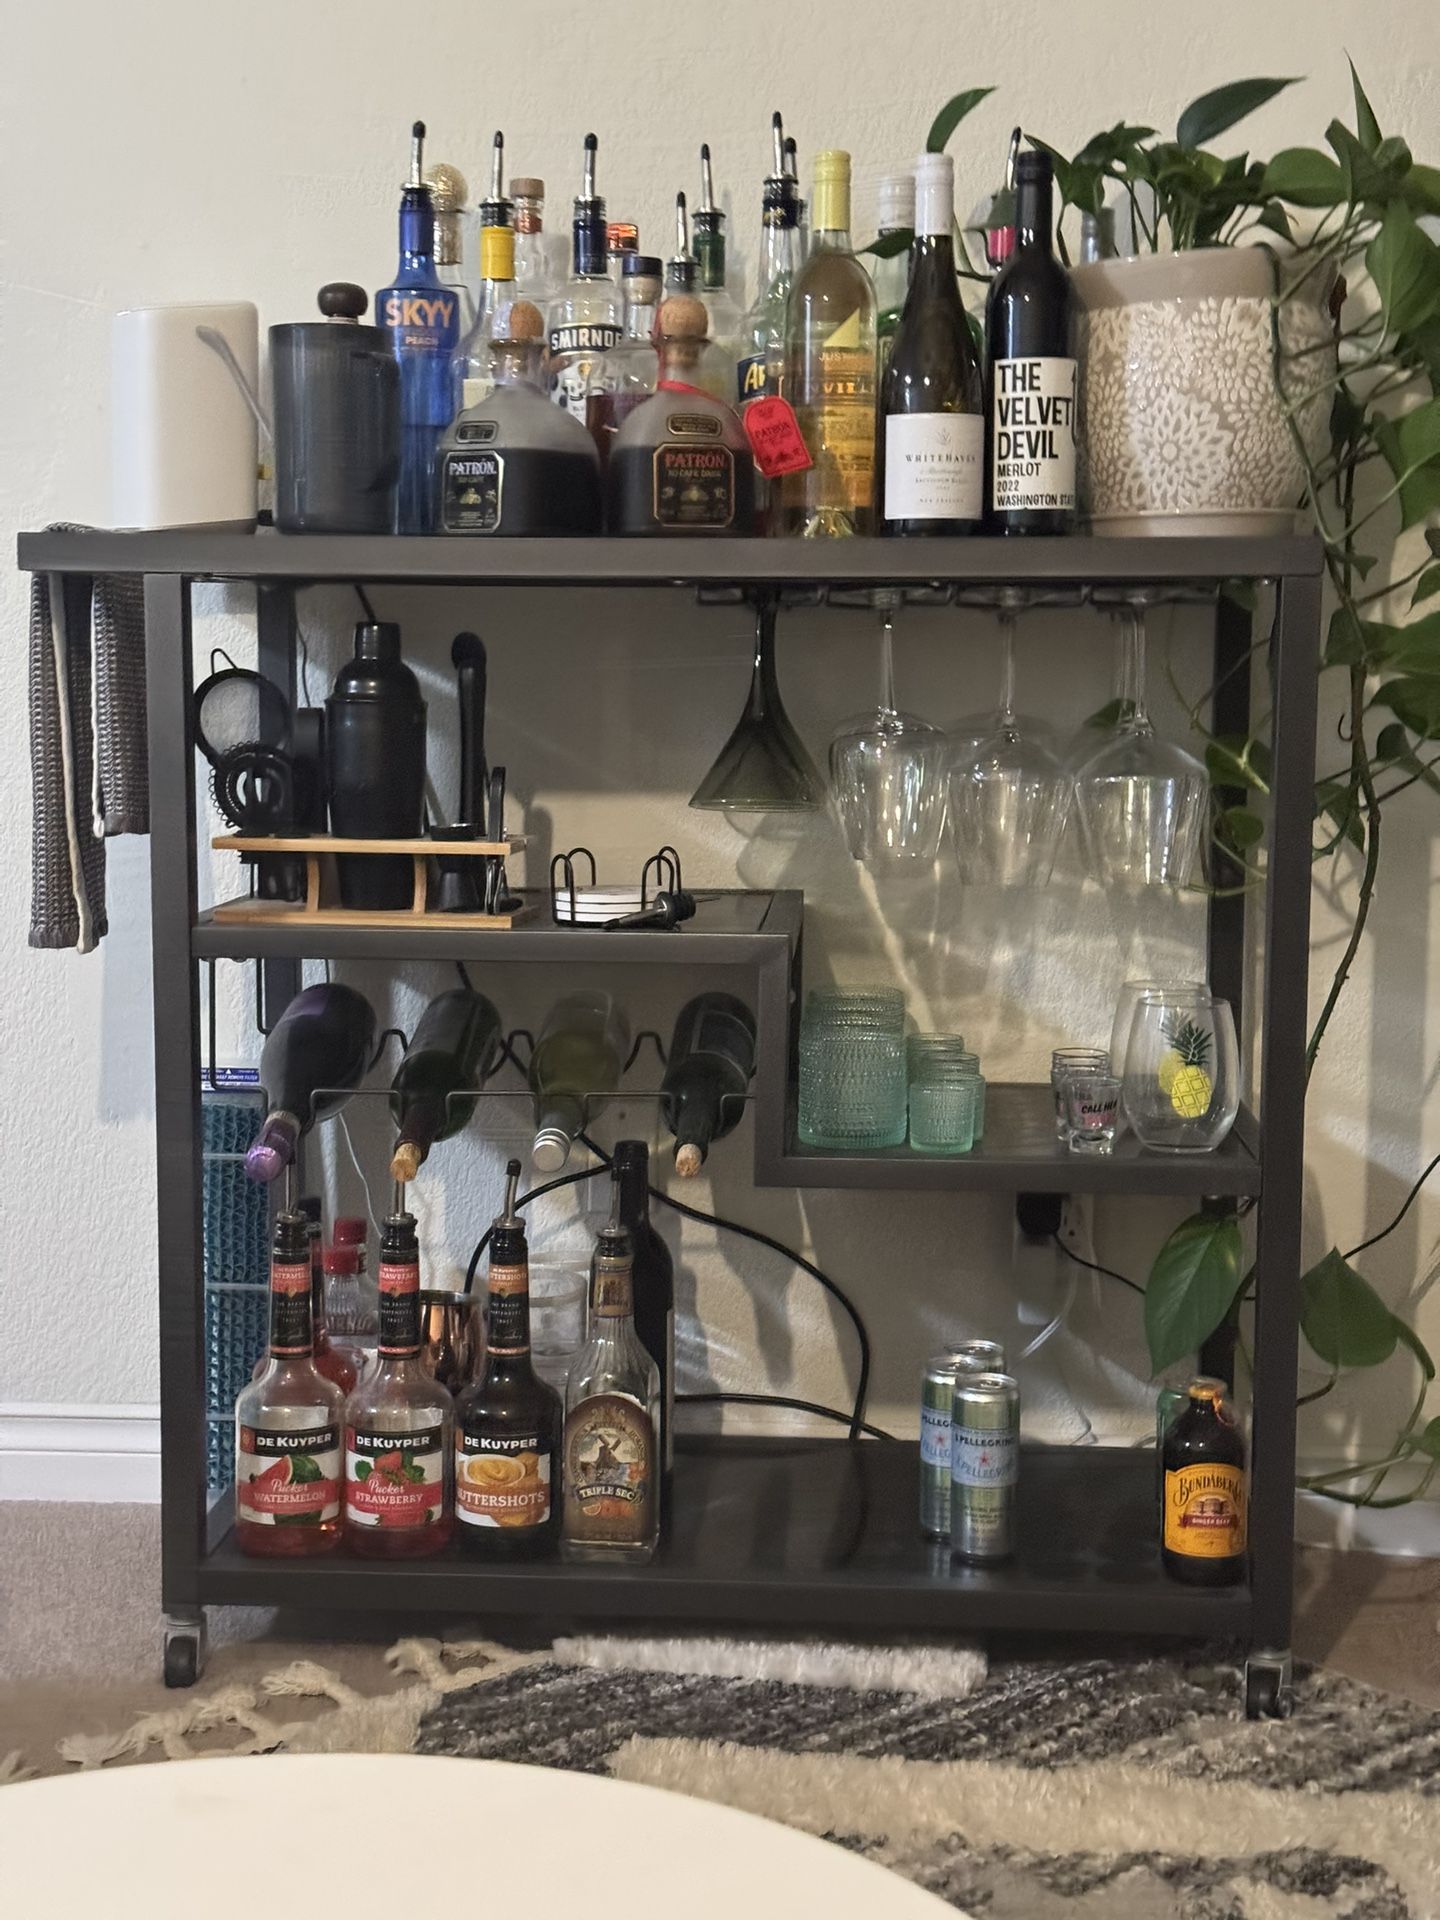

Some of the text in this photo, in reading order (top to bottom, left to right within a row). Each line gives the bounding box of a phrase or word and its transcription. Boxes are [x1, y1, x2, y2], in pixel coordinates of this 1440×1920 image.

[385, 298, 454, 328] SKYY
[999, 362, 1041, 393] THE
[998, 397, 1072, 427] VELVET
[998, 430, 1059, 460] DEVIL
[997, 462, 1042, 477] MERLOT
[997, 480, 1019, 492] 2022
[997, 494, 1057, 507] WASHINGTON
[1081, 1103, 1102, 1114] CALL
[254, 1490, 326, 1503] WATERMELON
[355, 1491, 424, 1505] STRAWBERRY
[579, 1486, 634, 1500] TRIPLE SEC
